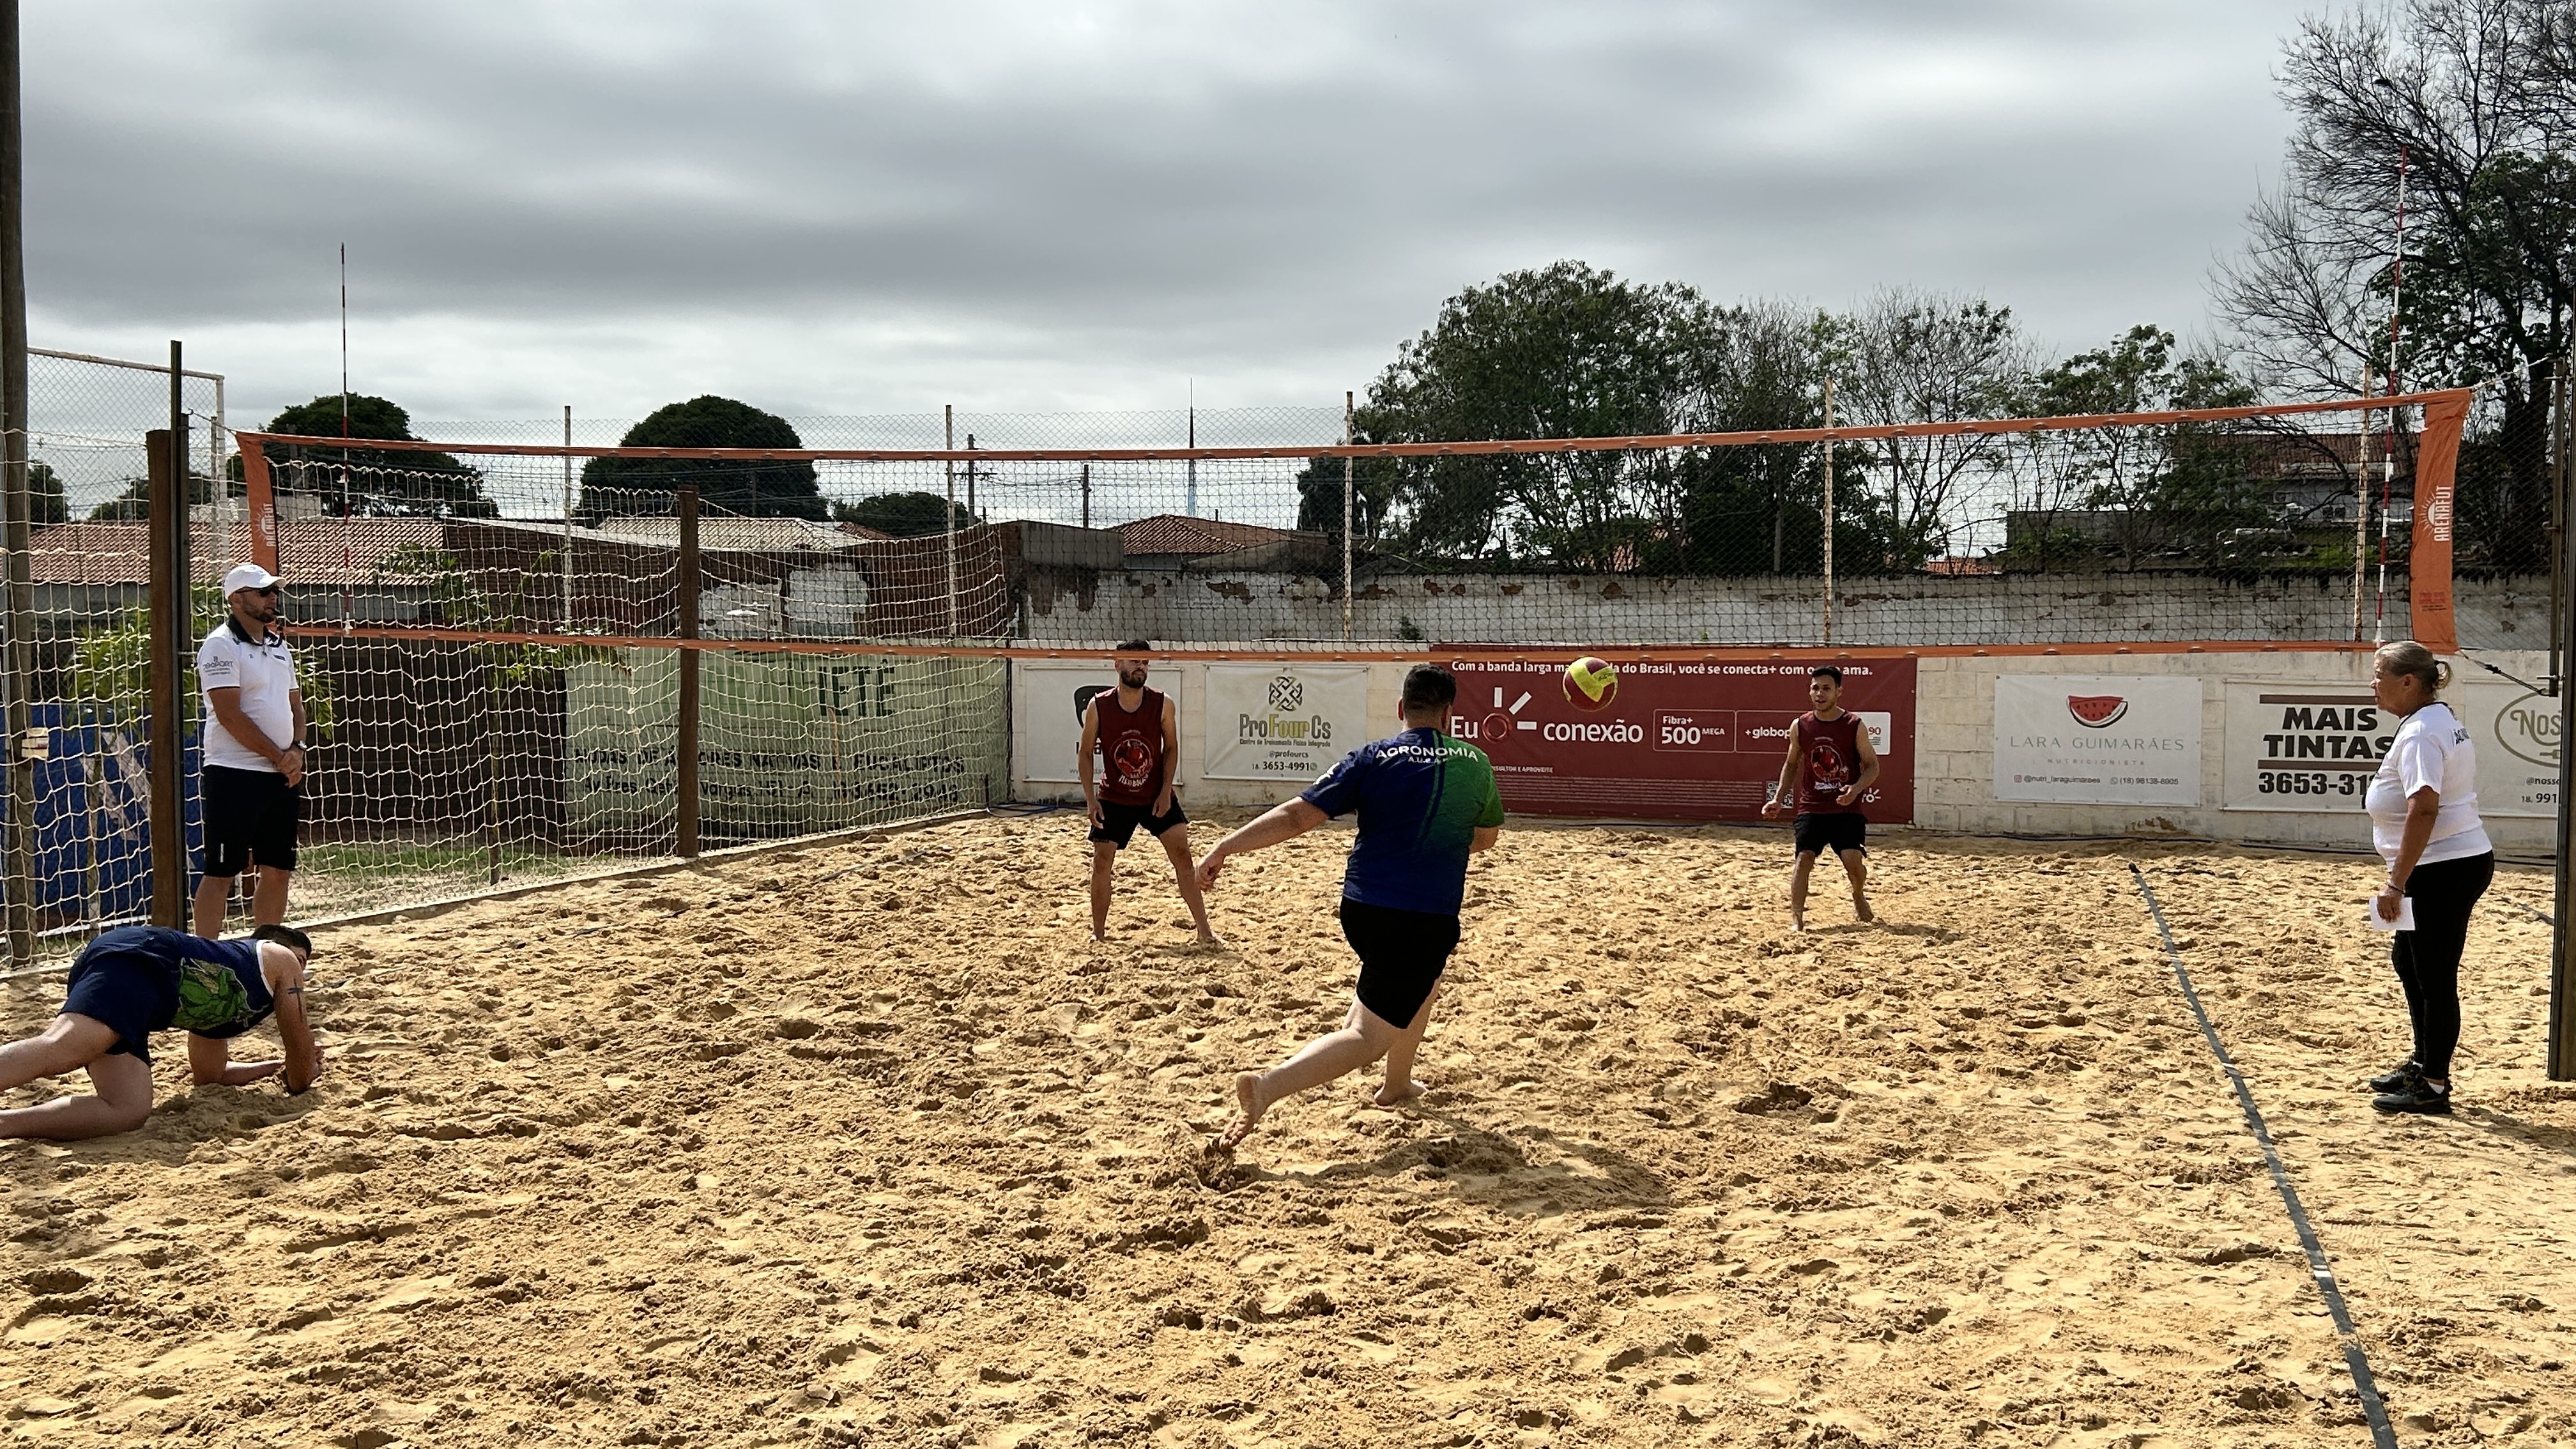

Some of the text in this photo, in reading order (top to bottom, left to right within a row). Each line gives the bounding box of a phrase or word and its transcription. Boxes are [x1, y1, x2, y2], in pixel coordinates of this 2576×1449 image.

[2434, 485, 2451, 542] ARENAFUT
[1452, 661, 1476, 671] Com
[1478, 663, 1485, 671] a
[1487, 661, 1521, 673] banda
[1523, 663, 1551, 675] larga
[1622, 663, 1637, 674] do
[1639, 663, 1676, 675] Brasil,
[1678, 663, 1705, 675] você
[1707, 665, 1720, 675] se
[1723, 665, 1777, 676] conecta+
[1779, 666, 1805, 675] com
[1843, 667, 1873, 675] ama.
[1450, 716, 1478, 739] Eu
[1662, 716, 1693, 724] Fibra+
[2282, 707, 2379, 732] MAIS
[1543, 719, 1644, 743] conexão
[1661, 727, 1701, 744] 500
[2010, 735, 2184, 751] LARA GUIMARÃES
[2263, 735, 2395, 760] TINTAS
[1376, 745, 1479, 762] AGRONOMIA
[1262, 761, 1310, 771] 3653-4991
[2258, 772, 2375, 795] 3653-31
